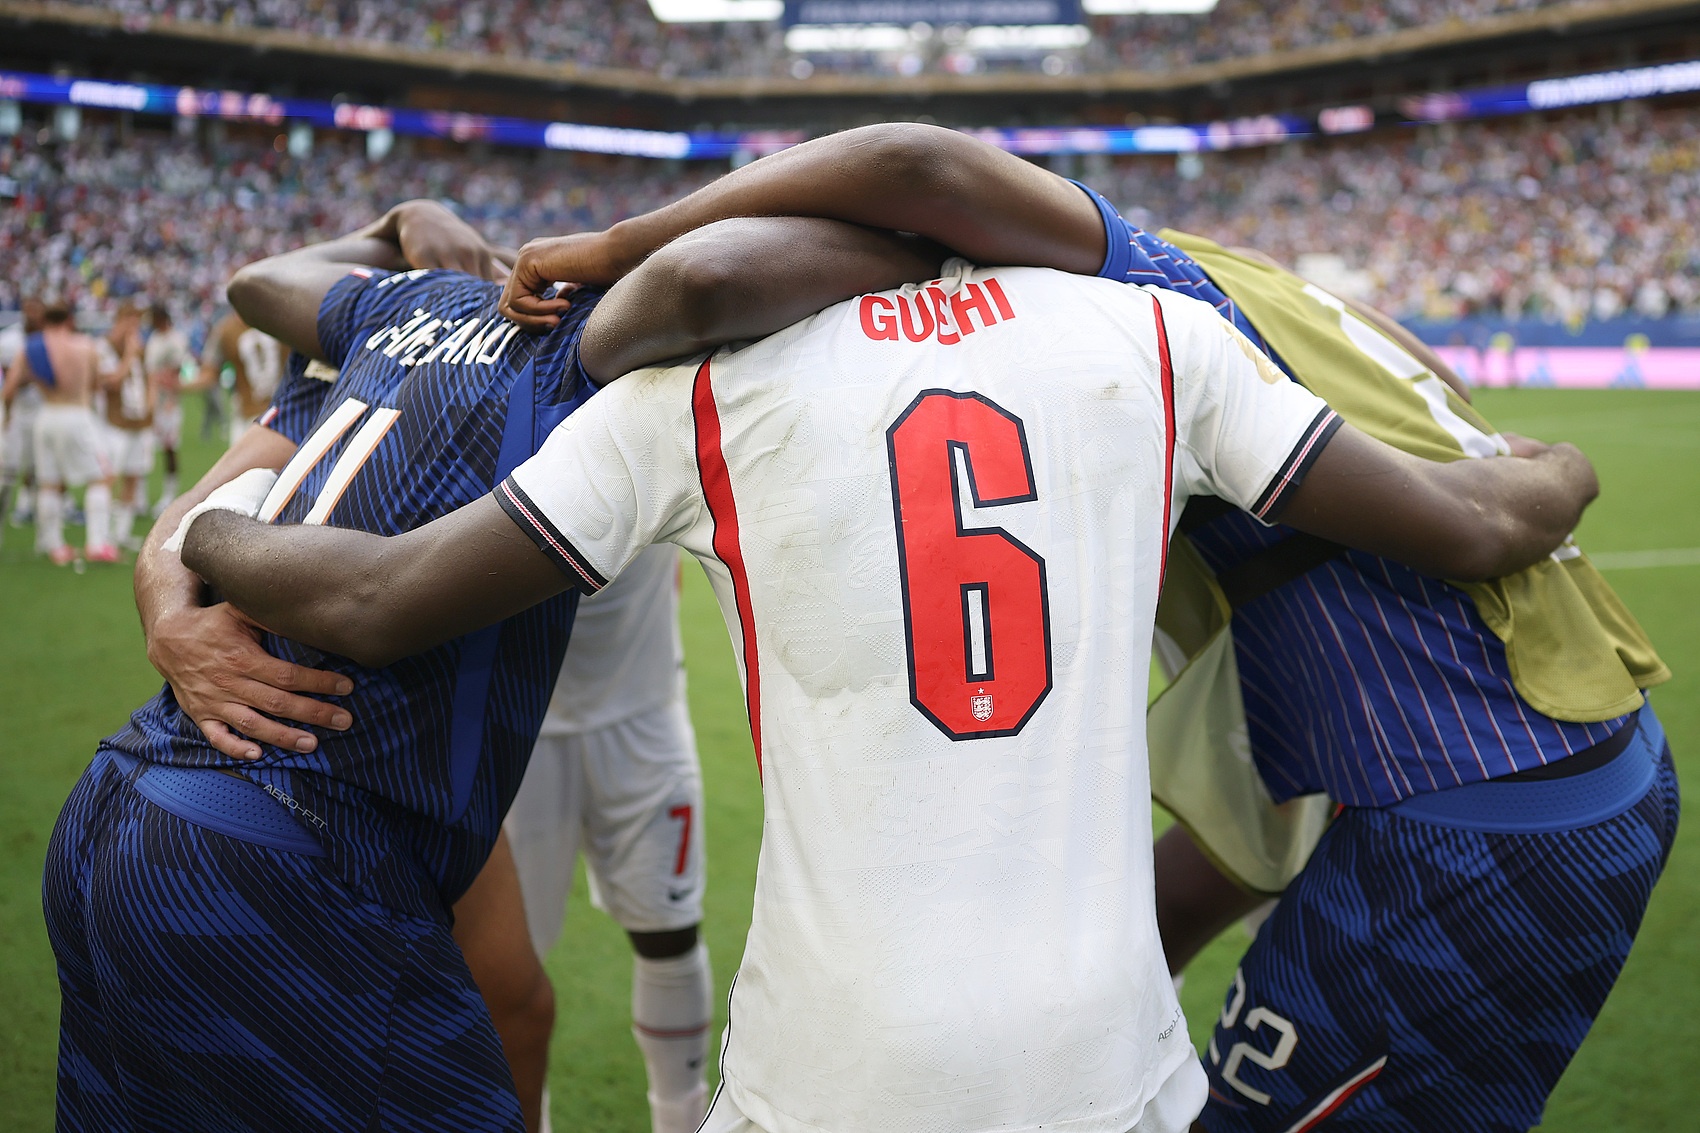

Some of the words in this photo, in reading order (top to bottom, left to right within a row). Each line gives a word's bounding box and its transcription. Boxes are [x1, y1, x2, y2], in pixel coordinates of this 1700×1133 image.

[886, 388, 1053, 742] 6
[263, 783, 328, 829] AERO-FIT
[669, 803, 693, 877] 7
